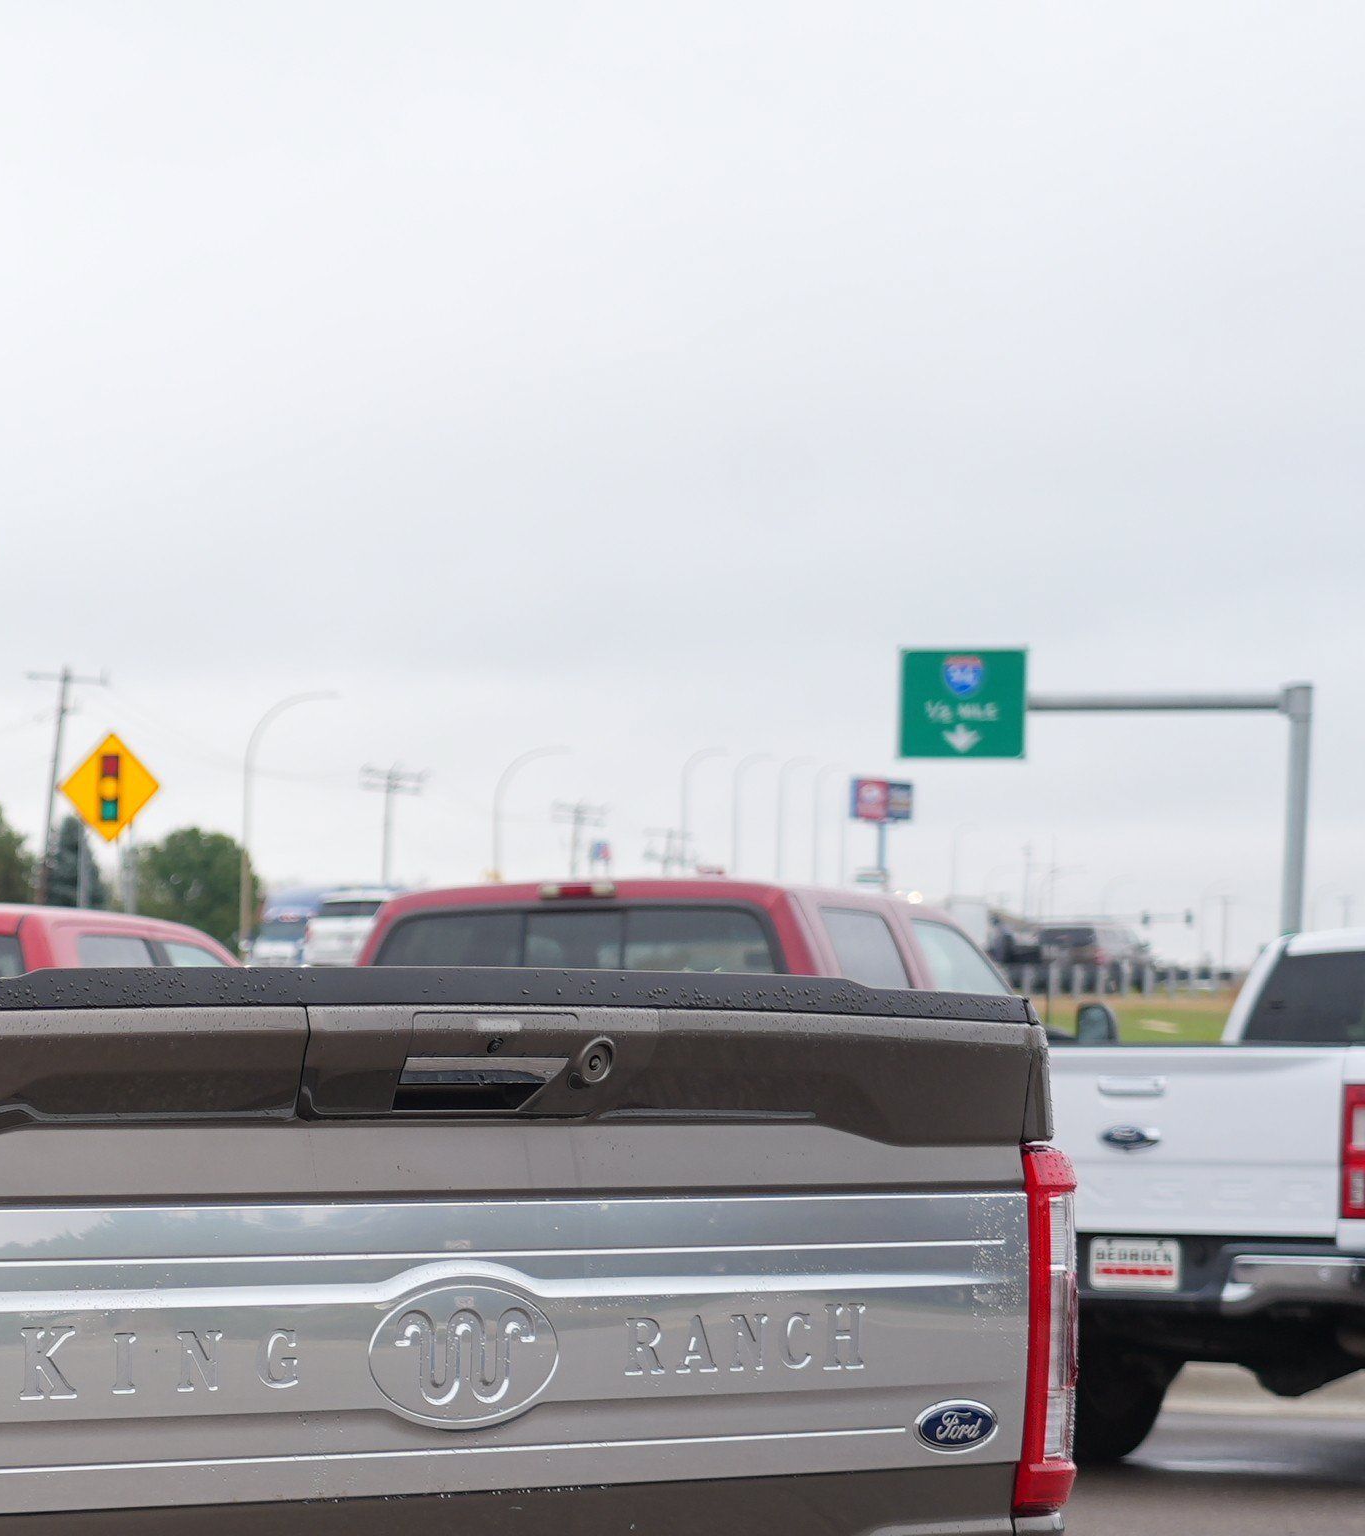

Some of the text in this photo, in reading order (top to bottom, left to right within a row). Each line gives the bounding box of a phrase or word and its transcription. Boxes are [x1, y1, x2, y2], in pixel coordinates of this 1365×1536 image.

[18, 1303, 867, 1401] KING RANCH
[935, 1410, 982, 1441] Ford
